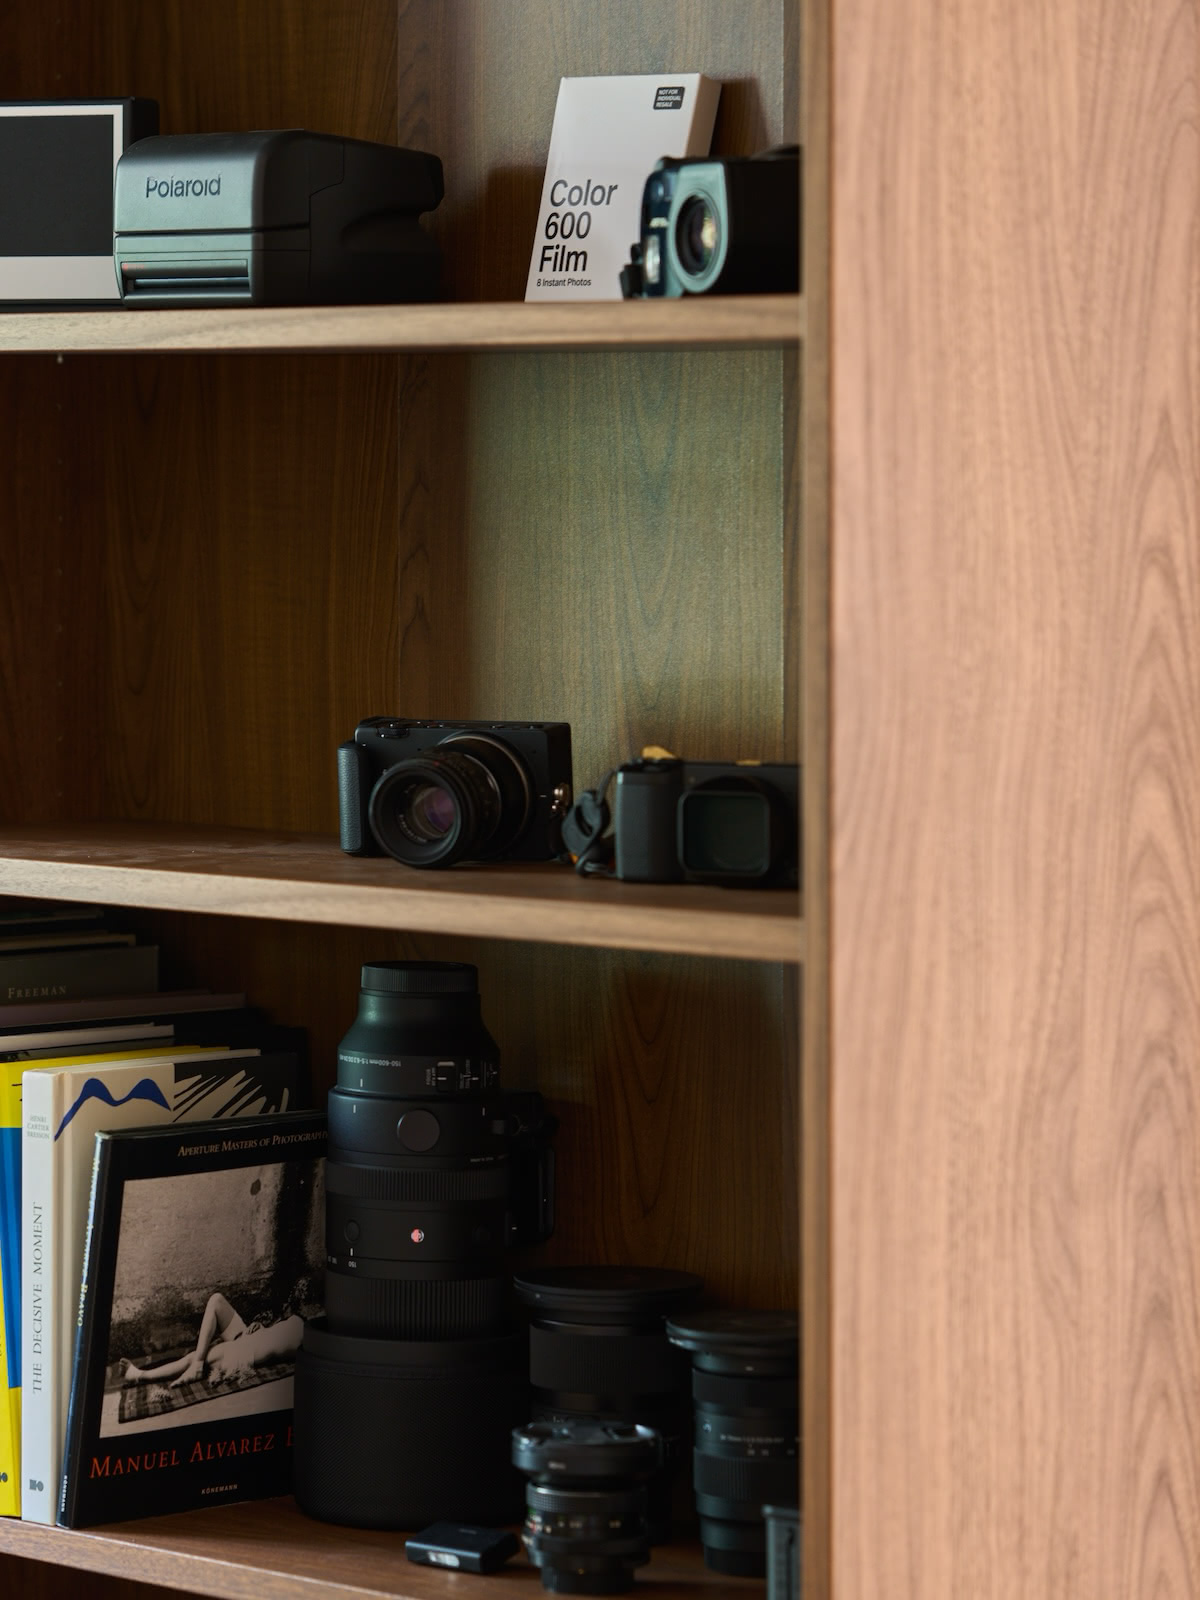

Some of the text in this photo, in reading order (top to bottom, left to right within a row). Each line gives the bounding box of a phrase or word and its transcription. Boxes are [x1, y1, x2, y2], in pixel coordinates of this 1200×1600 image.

[145, 174, 221, 198] Polaroid
[550, 179, 618, 207] Color
[544, 211, 592, 240] 600
[539, 244, 588, 272] Film
[536, 278, 592, 287] 8 Instant Photos
[7, 985, 66, 999] FREEMAN
[26, 1123, 49, 1131] CARTIER
[29, 1115, 47, 1123] HENRI
[26, 1131, 50, 1139] BRESSON
[177, 1143, 220, 1157] APERTURE
[221, 1138, 258, 1151] MASTERS
[32, 1201, 43, 1394] THE DECISIVE MOMENT
[89, 1448, 181, 1479] MANUEL
[189, 1433, 275, 1464] ALVAREZ
[201, 1483, 238, 1495] KÖNEMANN
